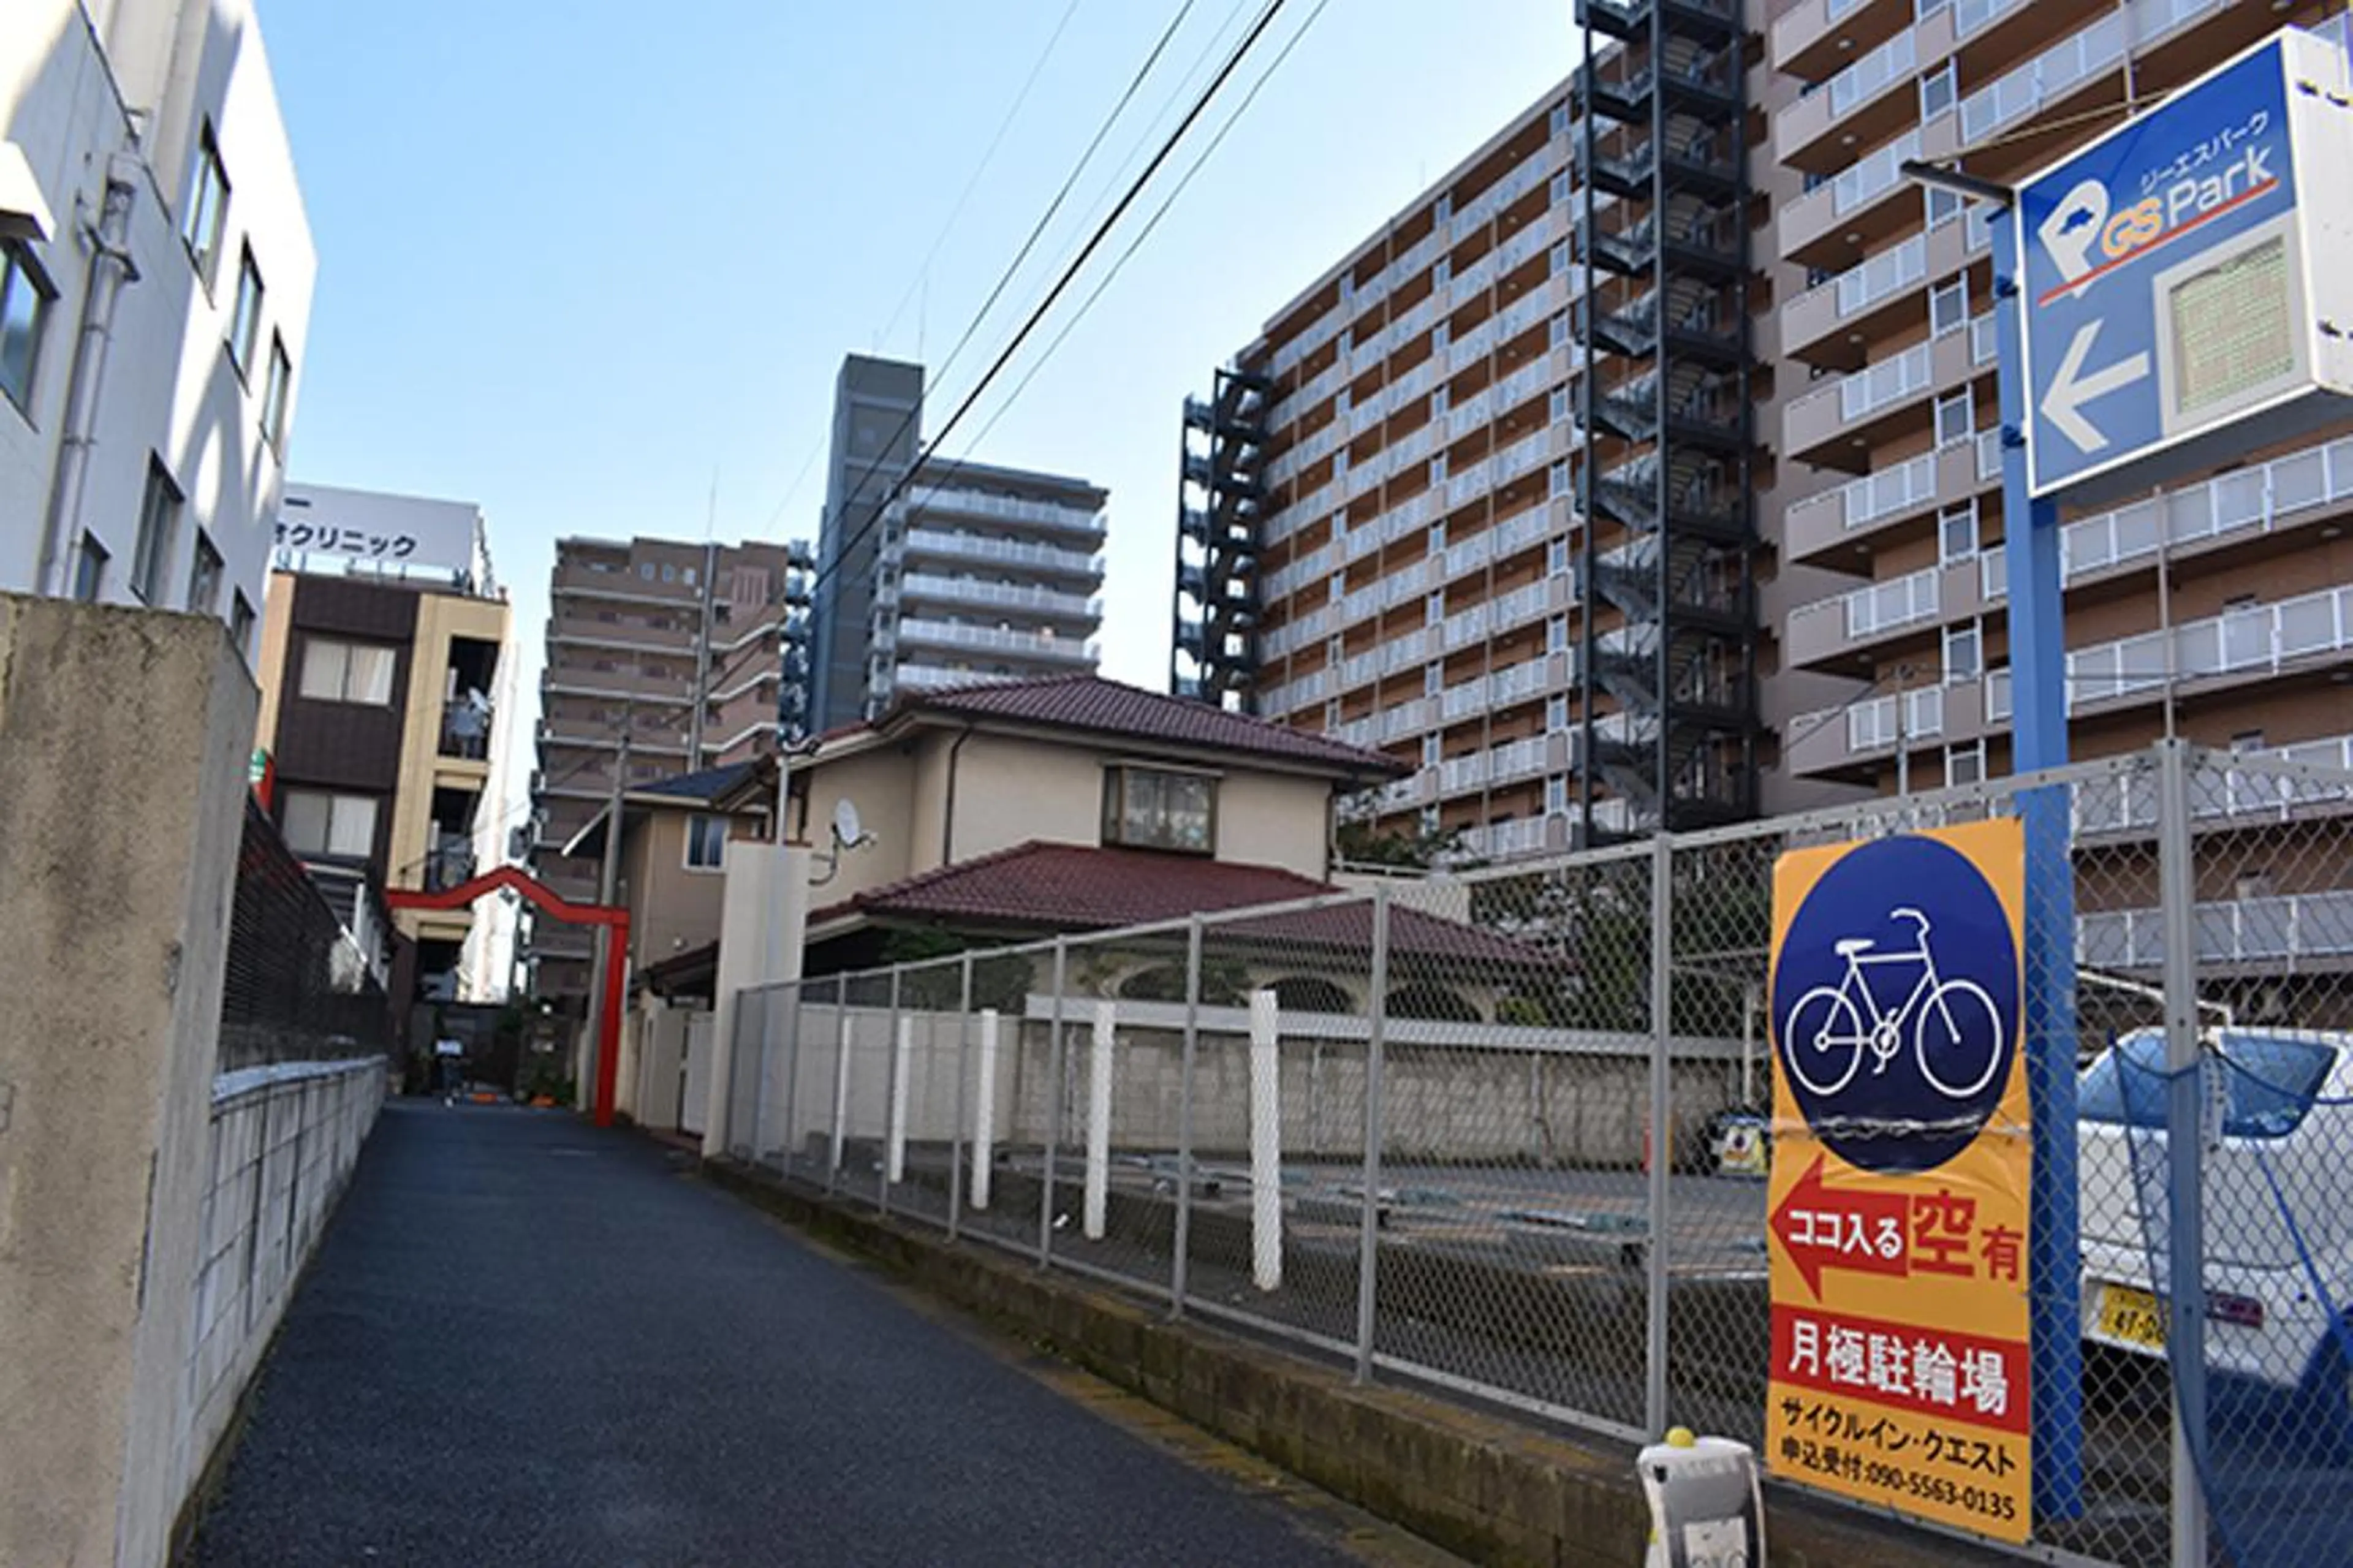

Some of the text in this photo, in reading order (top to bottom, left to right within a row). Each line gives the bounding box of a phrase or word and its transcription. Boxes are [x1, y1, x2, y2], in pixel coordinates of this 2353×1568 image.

[2102, 145, 2274, 258] GS Park
[1788, 1209, 1903, 1259] ココ入る
[1788, 1319, 2008, 1416] 月極駐輪場
